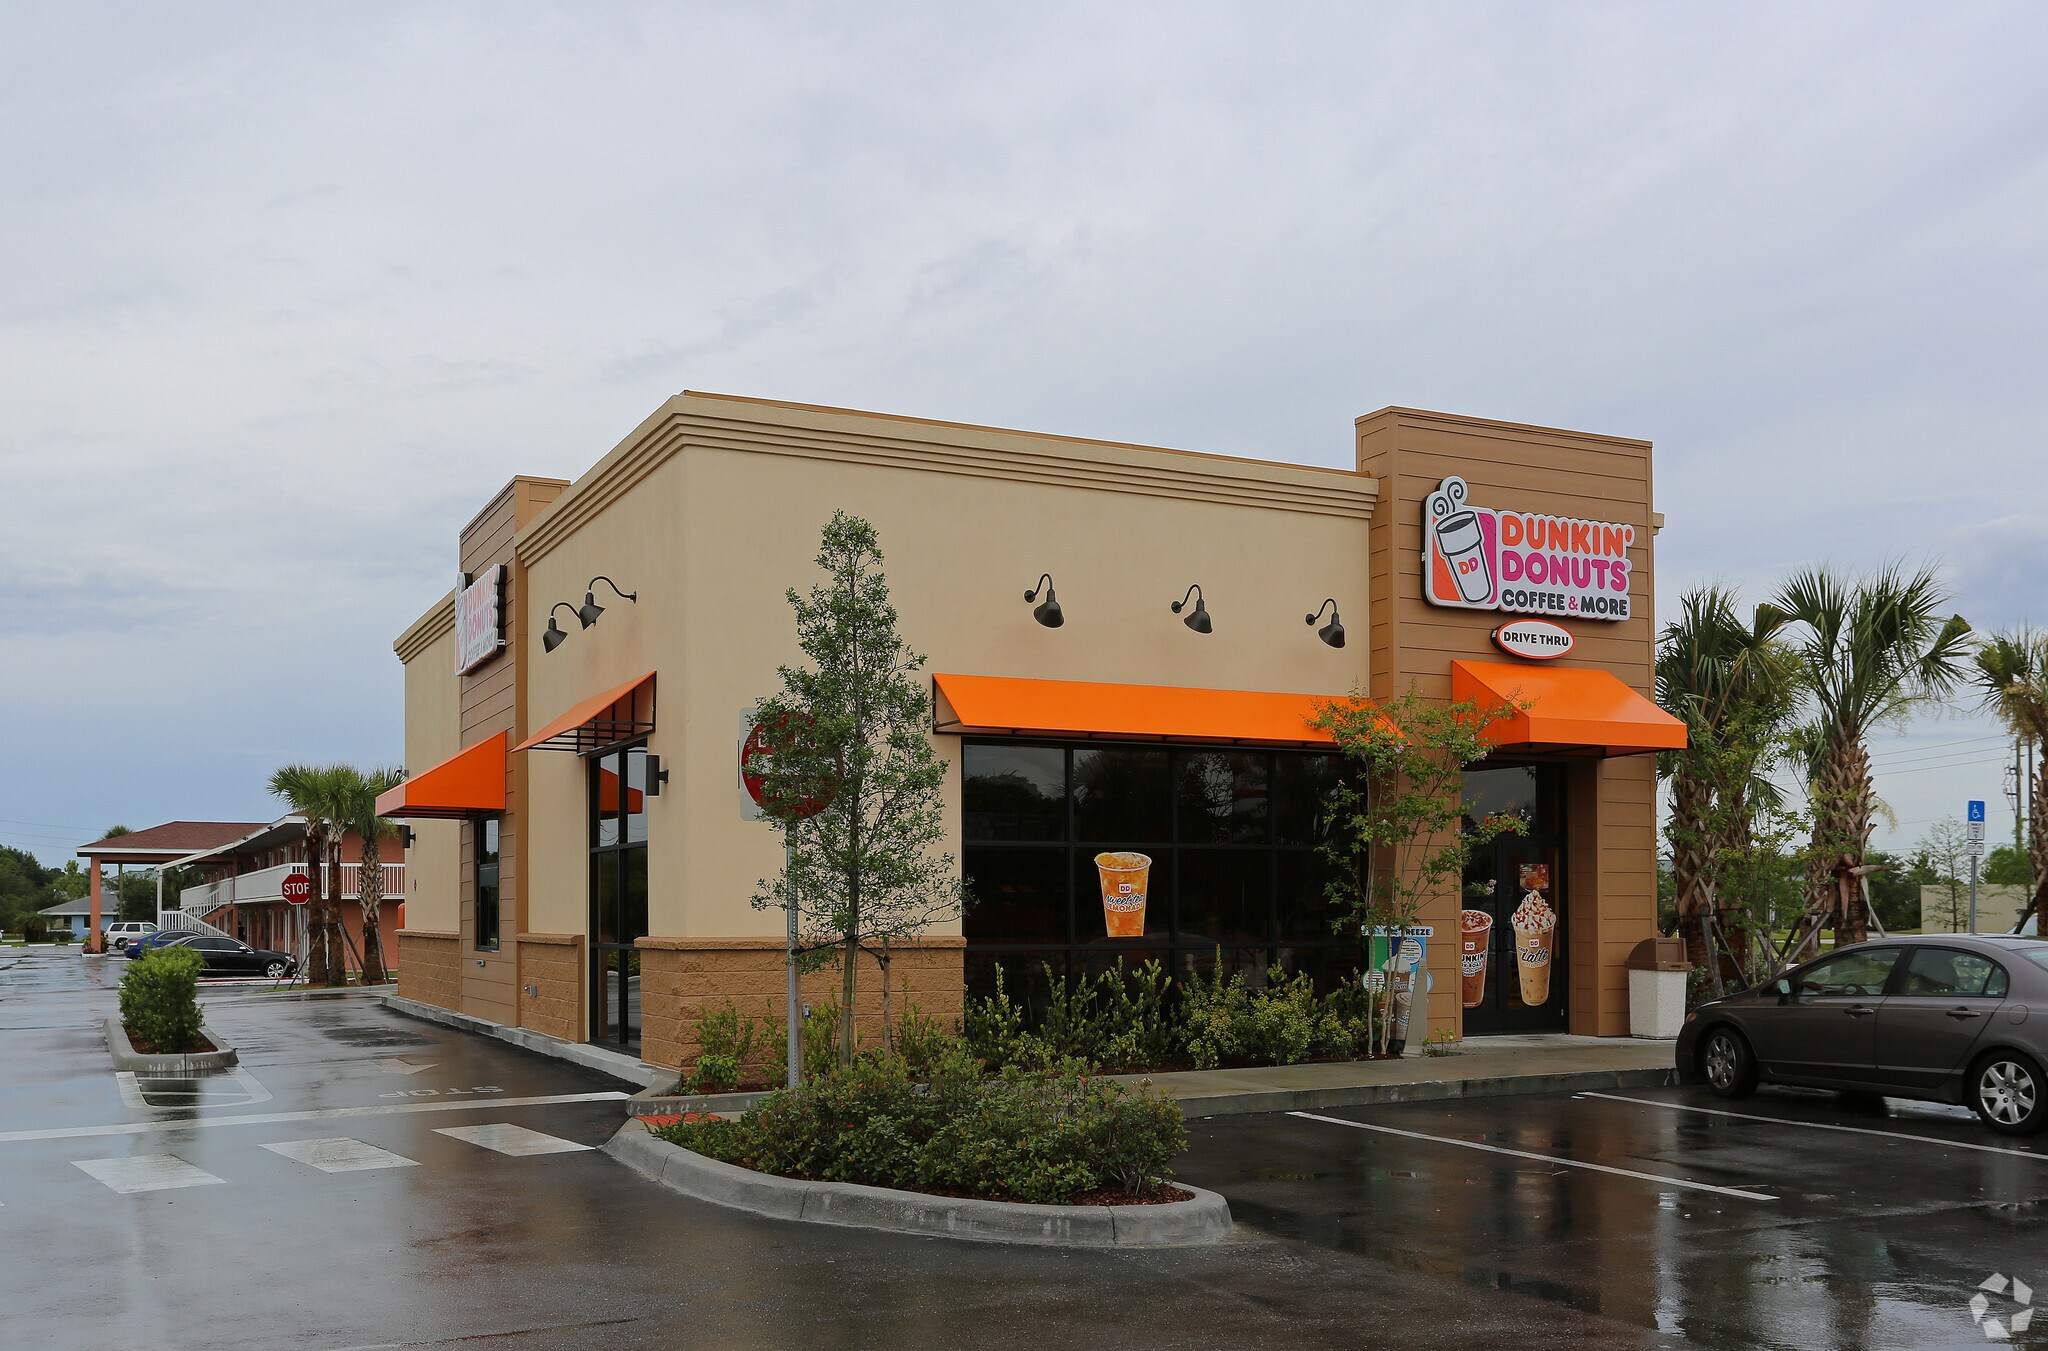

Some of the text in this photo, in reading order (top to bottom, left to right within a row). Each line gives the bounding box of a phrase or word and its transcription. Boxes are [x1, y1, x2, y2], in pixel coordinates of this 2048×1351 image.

[1502, 515, 1632, 557] DUNKIN'
[1458, 557, 1478, 574] DD
[1502, 588, 1628, 616] COFFEE & MORE
[1503, 631, 1537, 644] DRIVE
[1539, 634, 1569, 647] THRU
[378, 1085, 504, 1098] STOP
